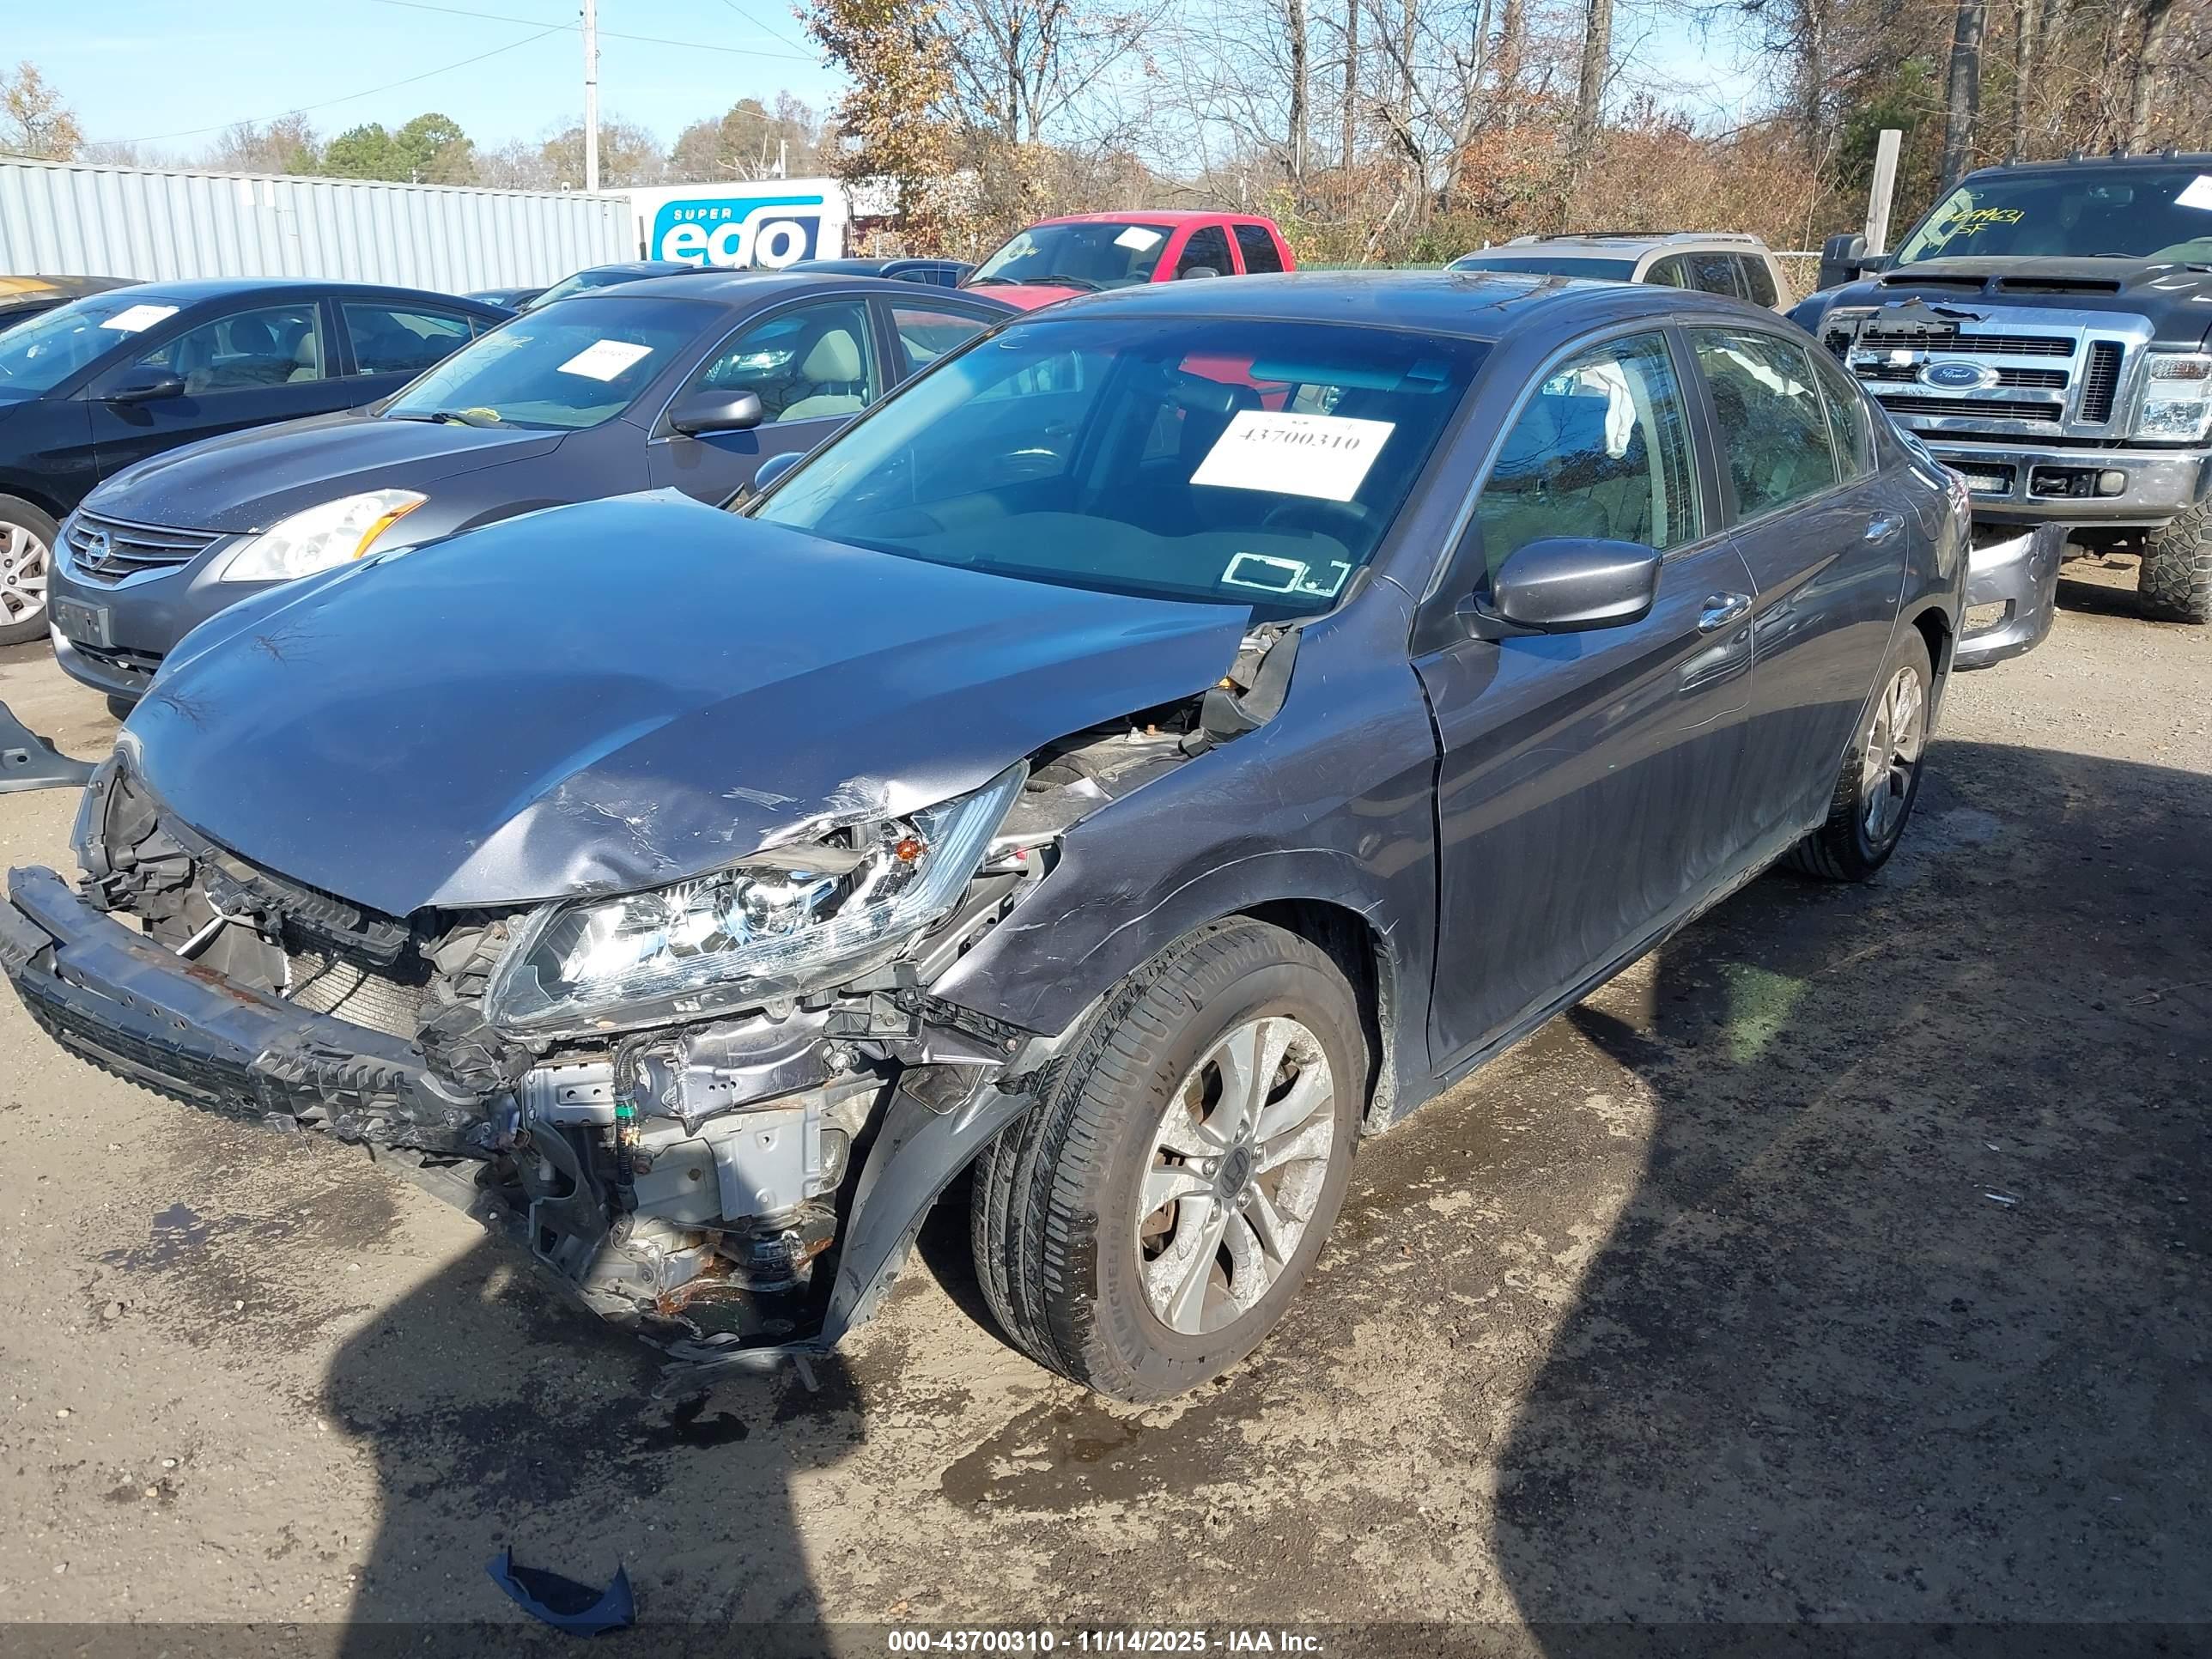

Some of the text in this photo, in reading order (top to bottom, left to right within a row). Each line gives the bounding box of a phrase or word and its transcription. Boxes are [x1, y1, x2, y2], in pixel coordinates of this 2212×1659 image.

[673, 207, 732, 221] SUPER
[1939, 368, 1971, 379] Ford
[1239, 428, 1360, 451] 43700310
